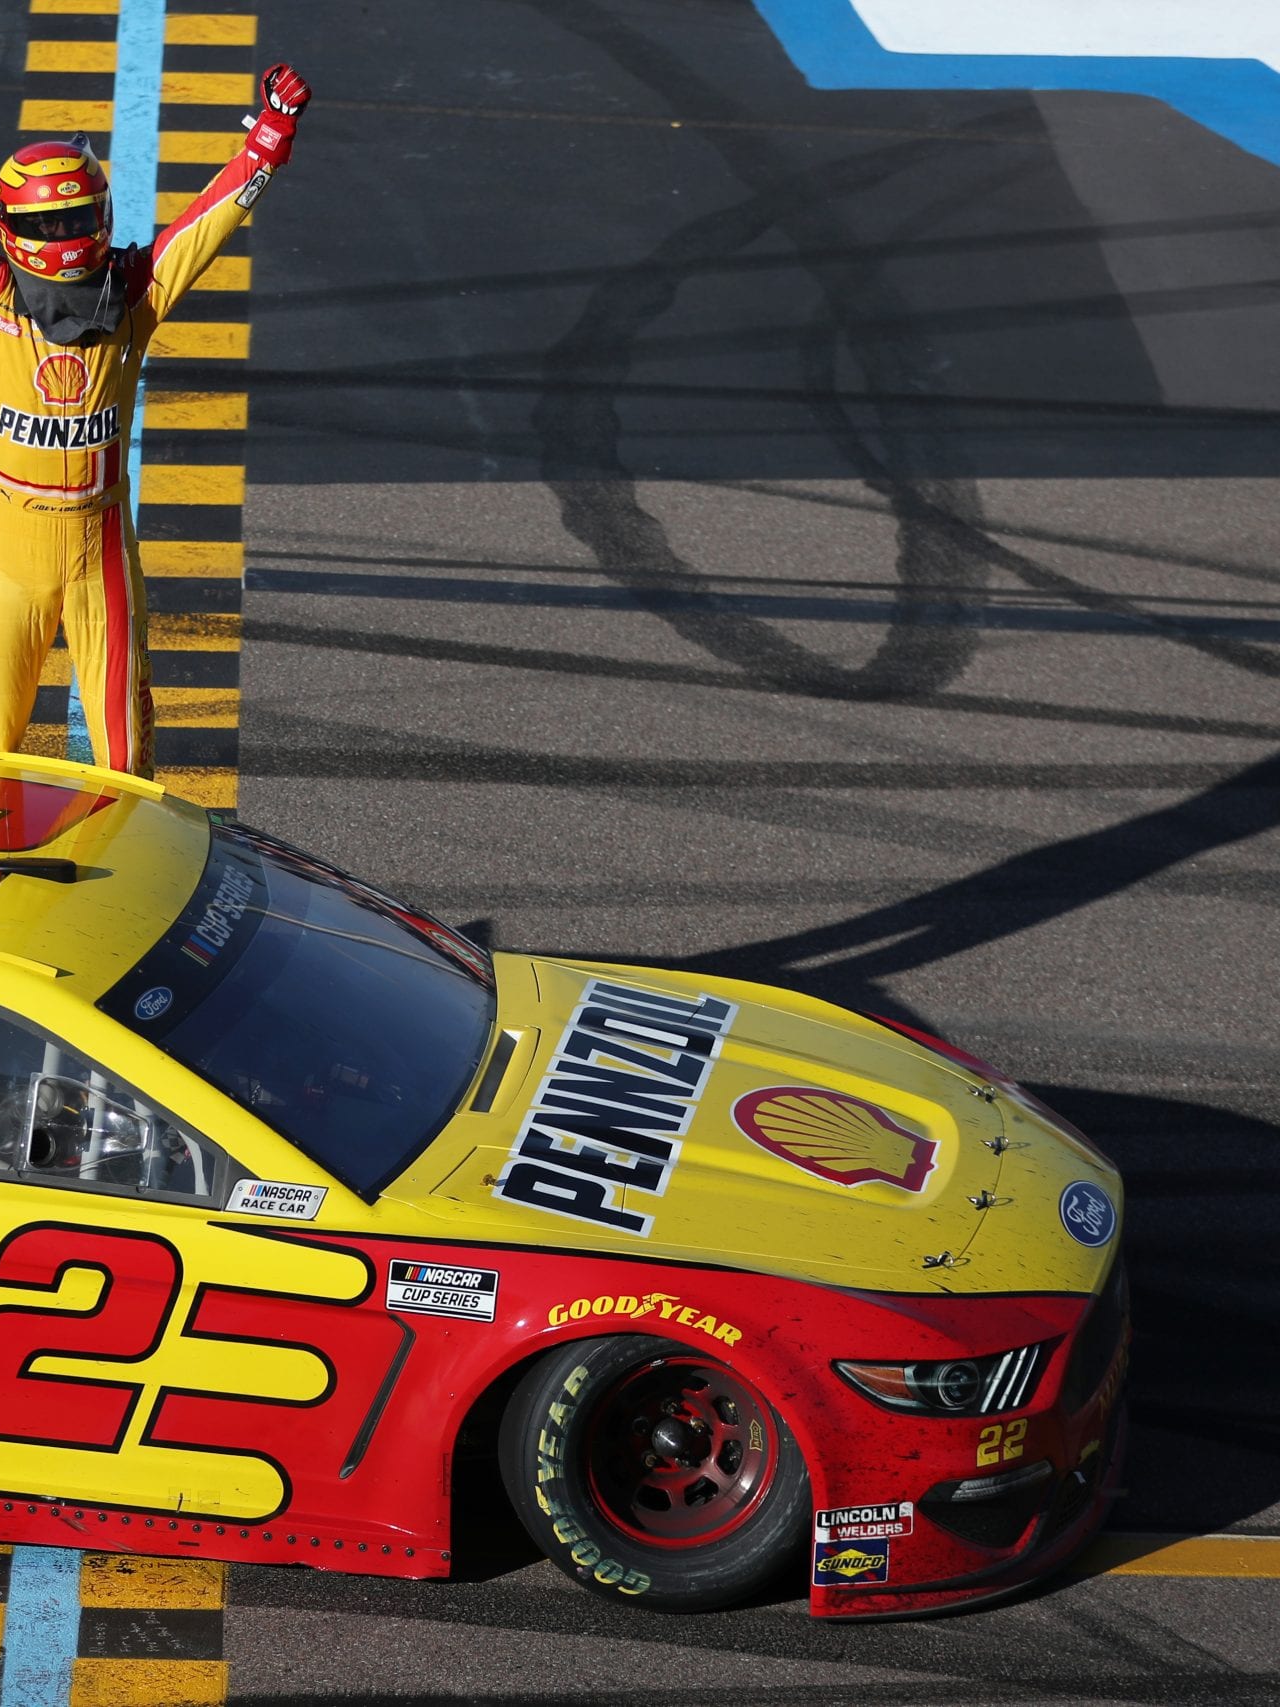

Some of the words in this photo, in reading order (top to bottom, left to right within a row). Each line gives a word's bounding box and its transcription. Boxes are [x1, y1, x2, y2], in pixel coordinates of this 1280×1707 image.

[32, 504, 57, 512] JOEY
[213, 865, 254, 920] SERIES
[196, 909, 234, 947] CUP
[140, 991, 168, 1016] Ford
[499, 980, 732, 1234] PENNZOIL
[261, 1186, 312, 1202] NASCAR
[240, 1198, 276, 1211] RACE
[279, 1203, 306, 1214] CAR
[1067, 1190, 1107, 1237] Ford
[423, 1267, 482, 1288] NASCAR
[402, 1288, 431, 1303] CUP
[433, 1291, 481, 1308] SERIES
[976, 1418, 1028, 1467] 22
[821, 1505, 896, 1526] LINCOLN
[837, 1522, 903, 1537] WELDERS
[819, 1556, 882, 1572] SUNOCO
